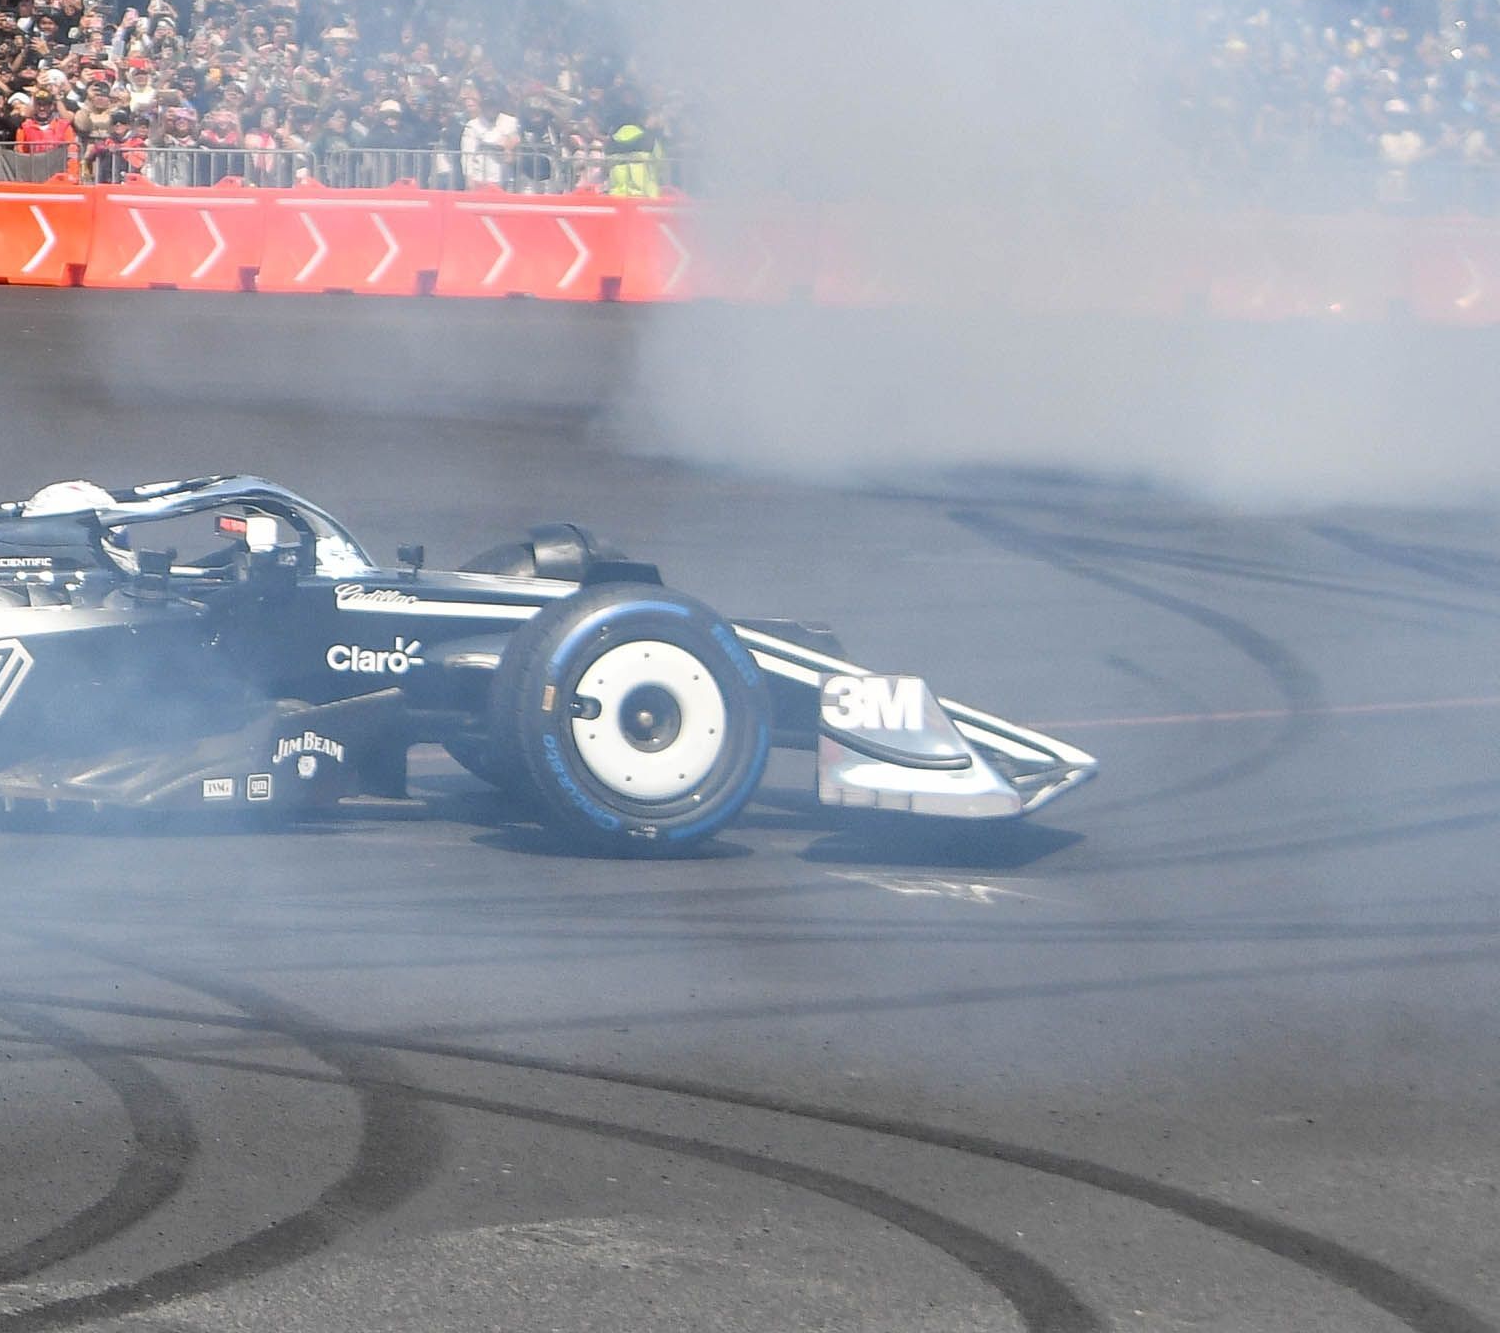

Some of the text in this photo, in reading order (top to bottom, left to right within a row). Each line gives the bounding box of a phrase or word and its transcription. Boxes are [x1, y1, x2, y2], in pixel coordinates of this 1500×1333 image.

[334, 583, 418, 604] Cadillac
[326, 643, 410, 674] Claro
[820, 675, 924, 730] 3M
[271, 731, 345, 763] JIM BEAM
